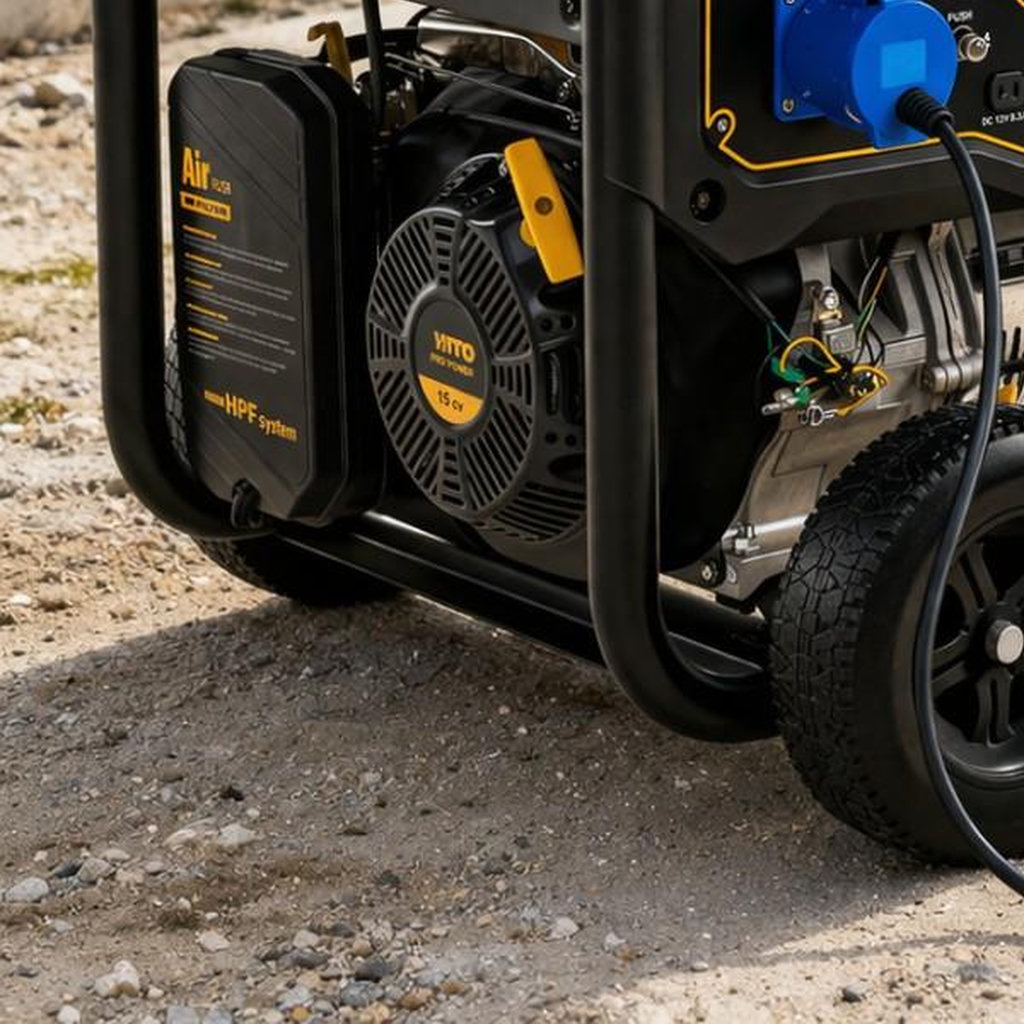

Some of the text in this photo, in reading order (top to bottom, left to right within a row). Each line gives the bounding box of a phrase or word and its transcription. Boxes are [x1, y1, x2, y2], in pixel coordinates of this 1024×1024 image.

[182, 146, 211, 190] Air
[225, 391, 258, 425] HPF
[258, 413, 298, 443] system
